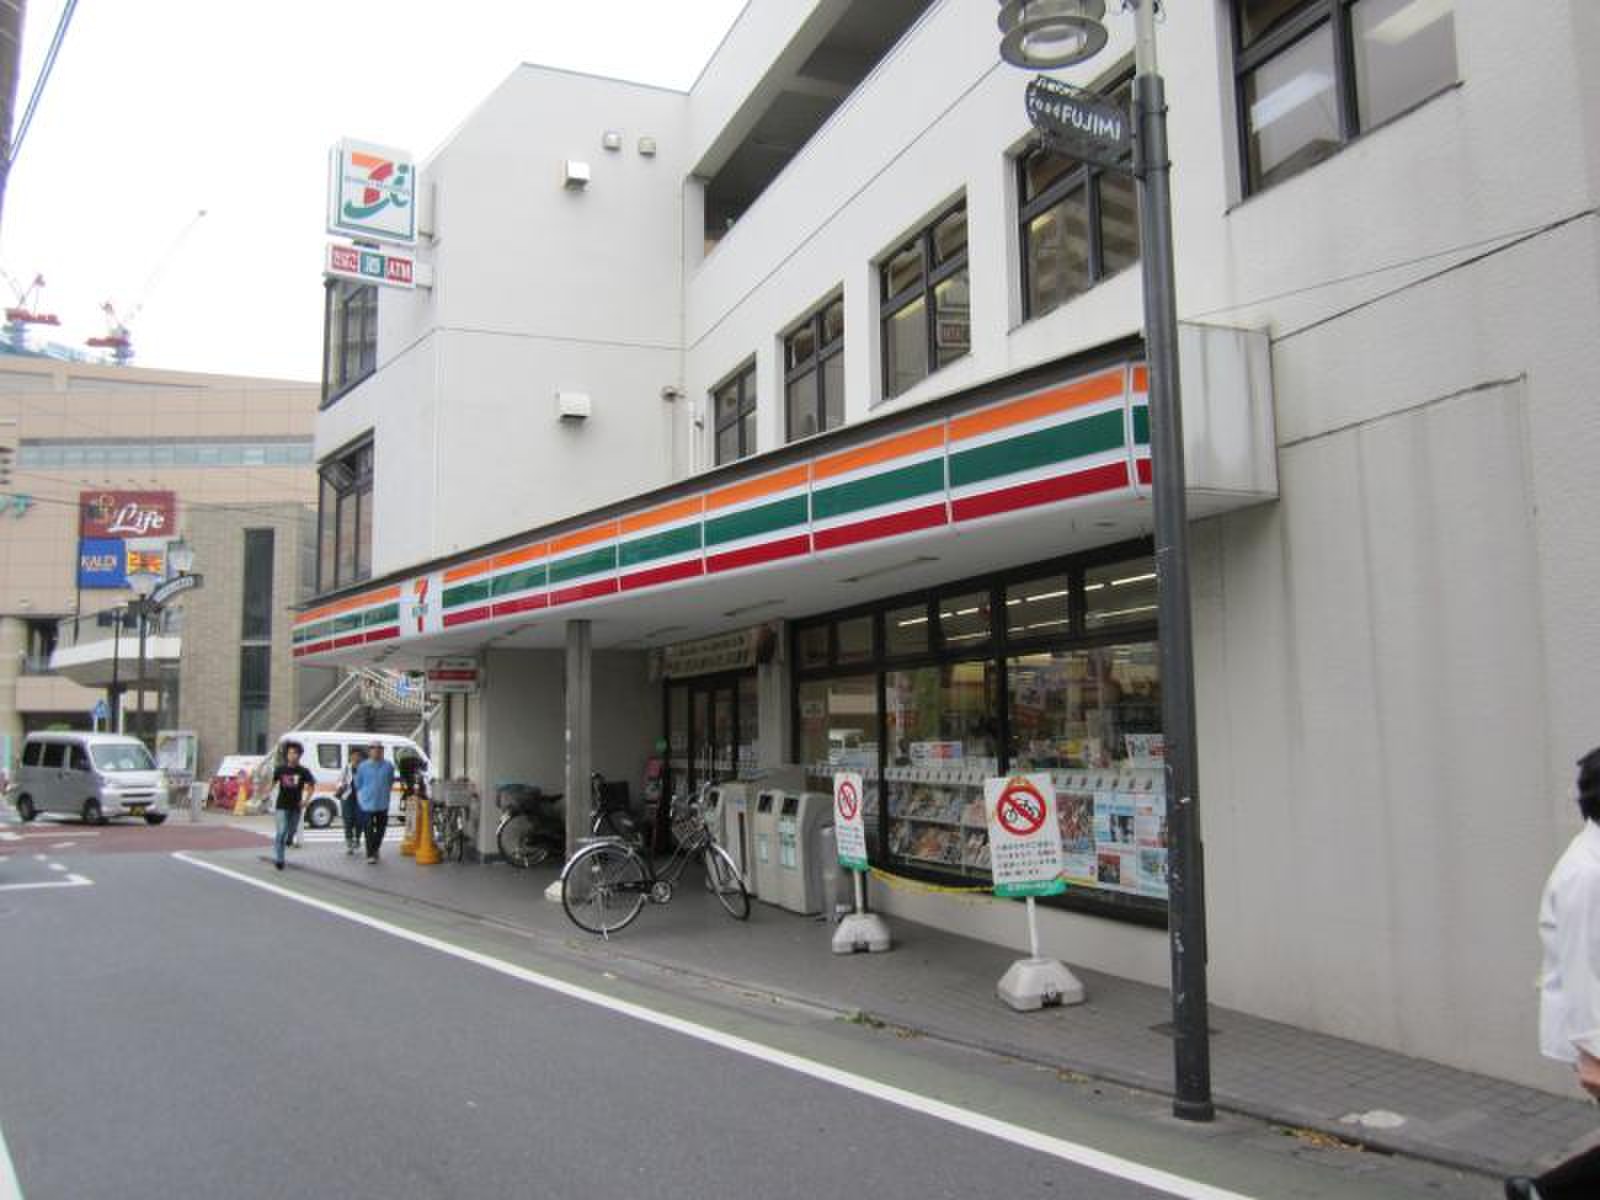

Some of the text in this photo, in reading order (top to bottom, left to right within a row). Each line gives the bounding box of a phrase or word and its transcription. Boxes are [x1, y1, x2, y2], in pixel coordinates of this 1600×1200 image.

[1061, 104, 1121, 141] FUJIMI
[388, 261, 410, 280] ATM
[106, 502, 165, 534] Life
